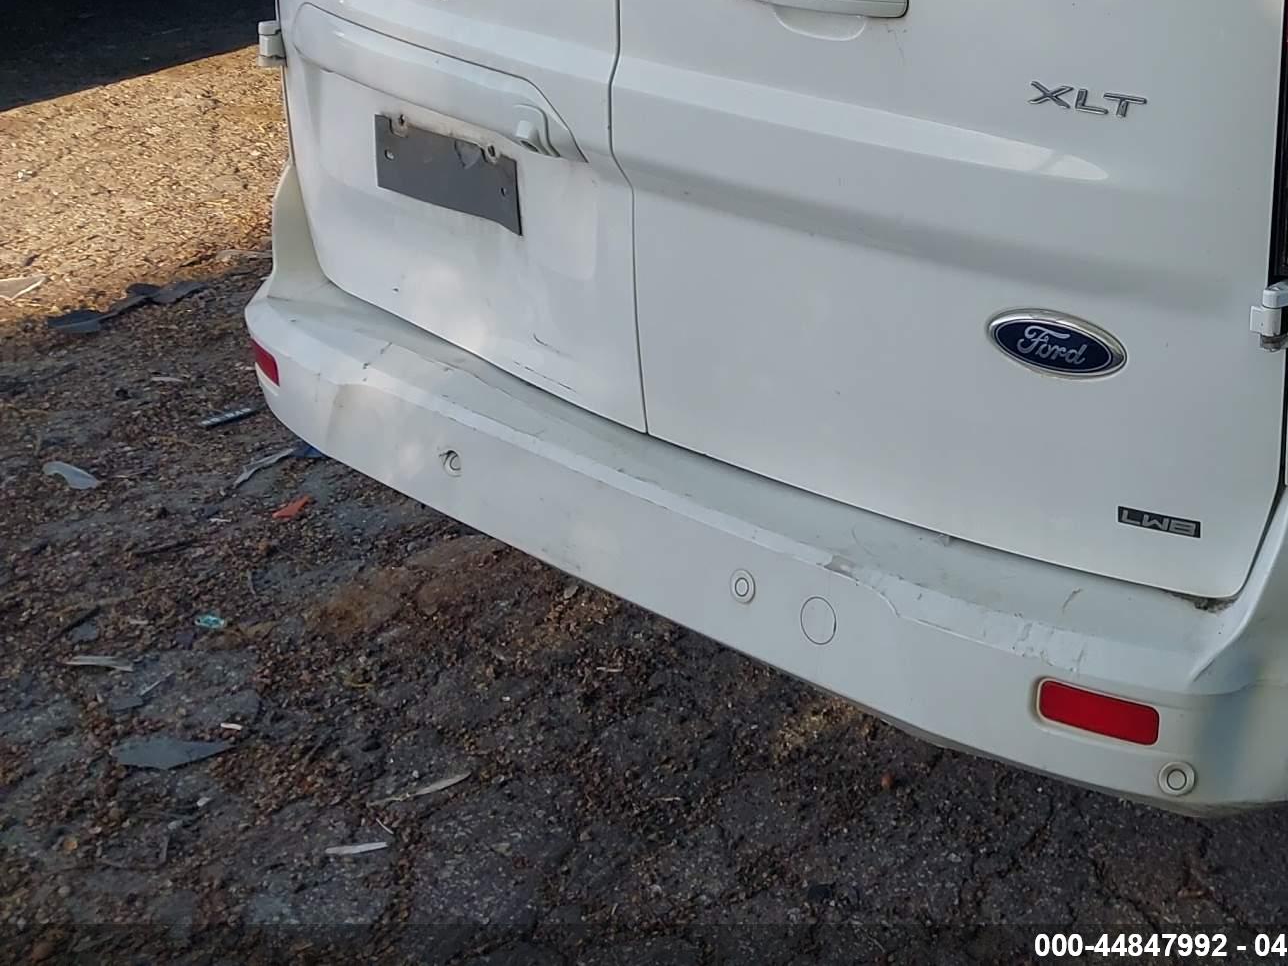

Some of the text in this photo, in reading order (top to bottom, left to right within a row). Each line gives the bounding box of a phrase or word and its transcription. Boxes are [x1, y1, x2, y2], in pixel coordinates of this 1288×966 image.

[1028, 80, 1148, 119] XLT
[1017, 325, 1088, 365] Ford
[1120, 509, 1197, 537] LWB
